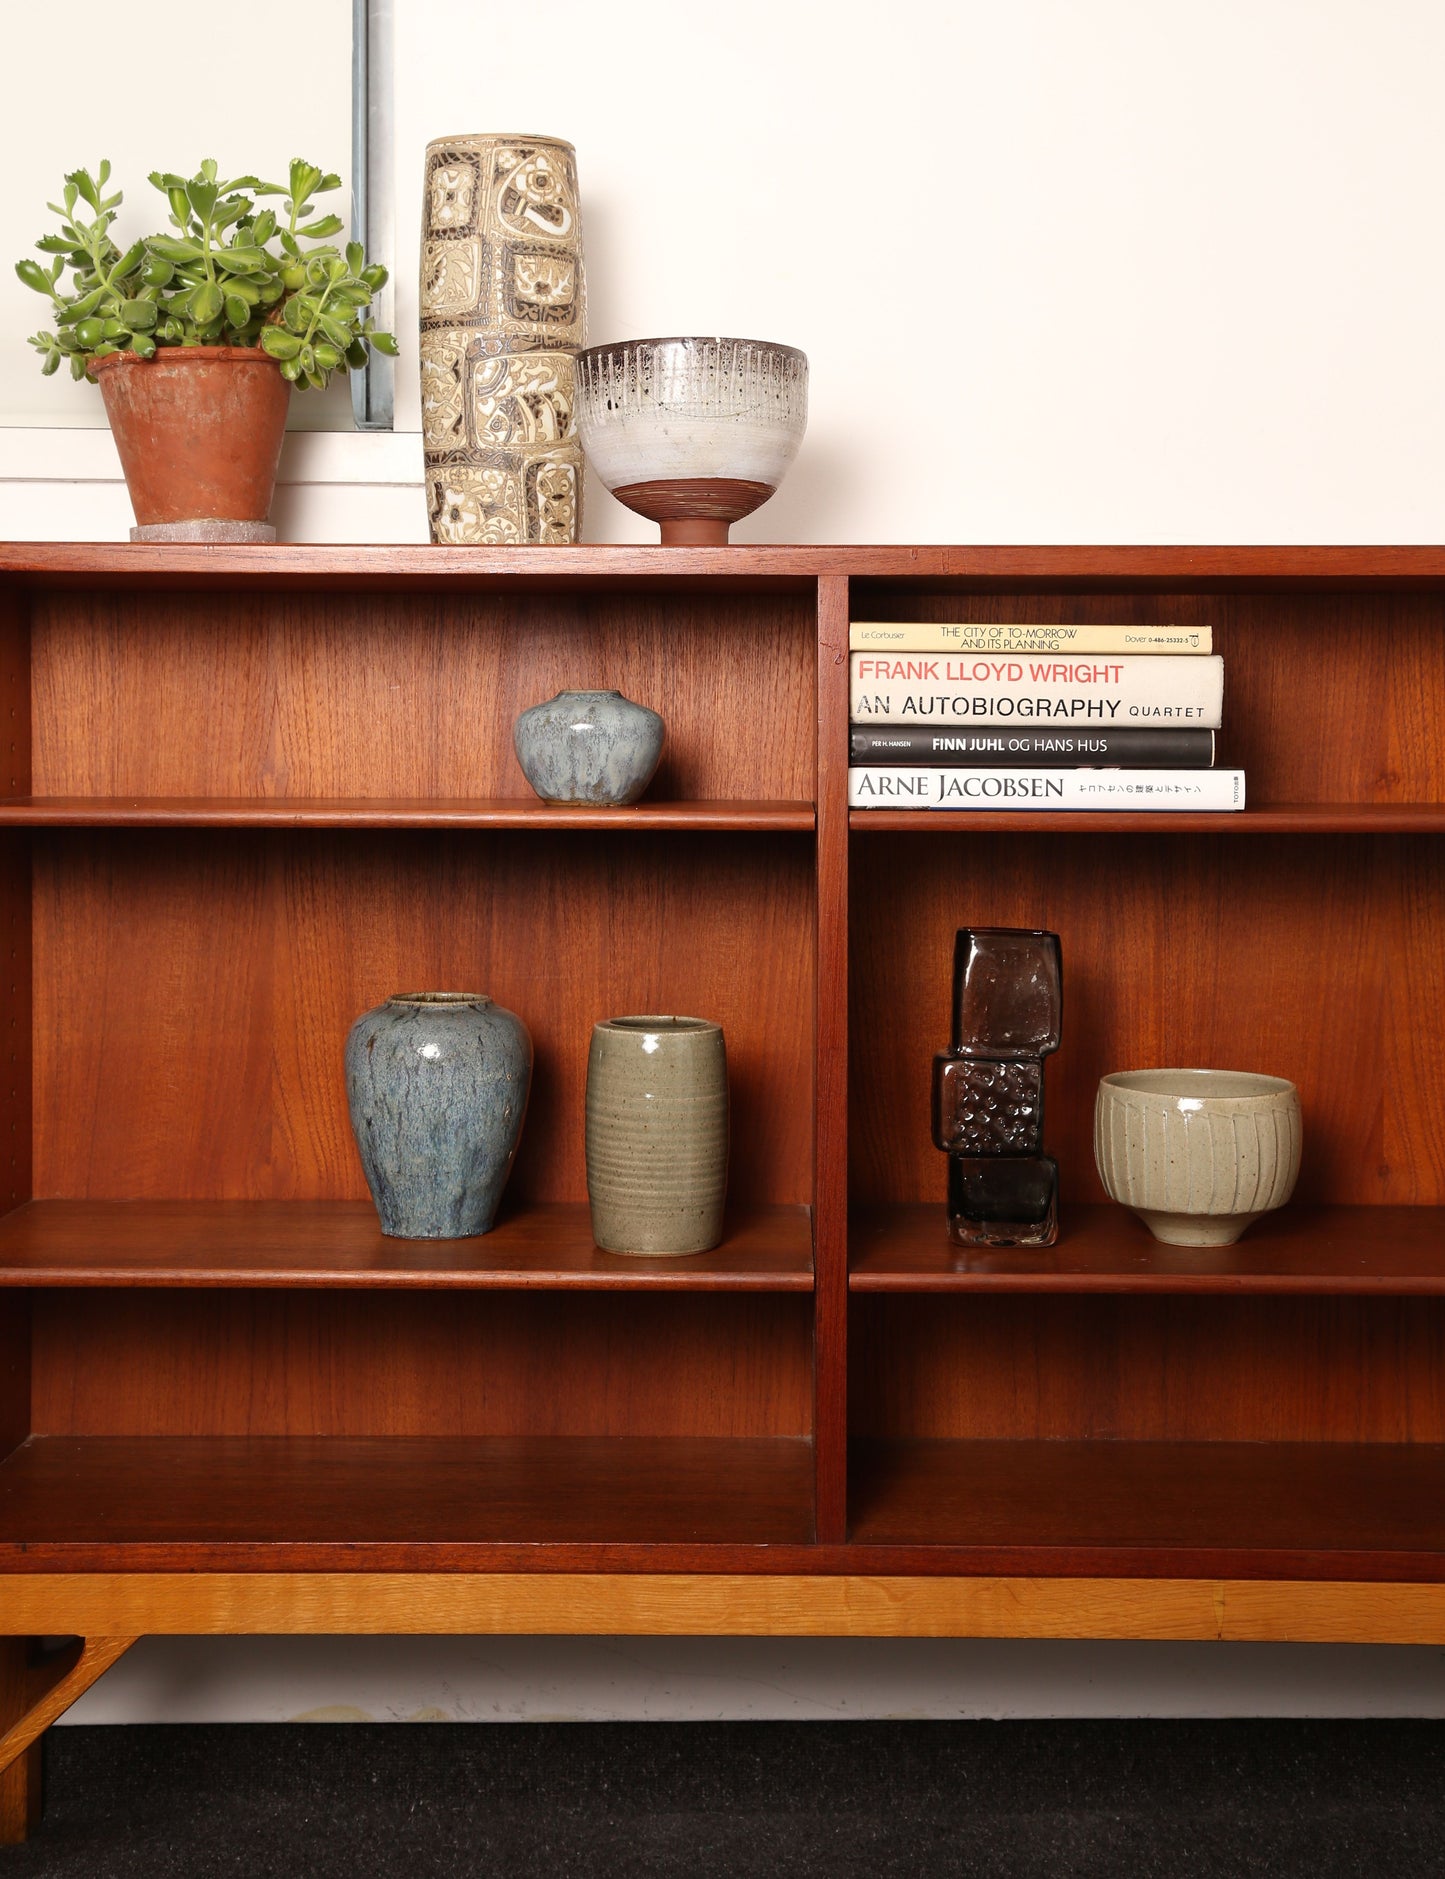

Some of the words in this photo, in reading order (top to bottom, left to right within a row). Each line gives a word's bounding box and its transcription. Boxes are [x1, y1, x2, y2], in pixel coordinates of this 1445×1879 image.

[861, 631, 869, 640] Le
[870, 630, 905, 640] Corbusier
[941, 627, 961, 638] THE
[964, 627, 986, 638] CITY
[988, 628, 1004, 638] OF
[1007, 628, 1077, 639] TO-MORROW
[1125, 635, 1147, 643] Dover
[960, 638, 986, 649] AND
[987, 639, 1002, 649] ITS
[1003, 639, 1060, 650] PLANNING
[860, 661, 939, 680] FRANK
[947, 662, 1023, 681] LLOYD
[1029, 664, 1124, 683] WRIGHT
[857, 696, 889, 713] AN
[902, 696, 1121, 717] AUTOBIOGRAPHY
[1129, 706, 1204, 717] QUARTET
[931, 738, 967, 752] FINN
[968, 738, 1005, 752] JUHL
[1008, 739, 1030, 752] OG
[1035, 739, 1073, 751] HANS
[1078, 740, 1107, 751] HUS
[857, 773, 929, 796] ARNE
[937, 775, 1063, 802] JACOBSEN
